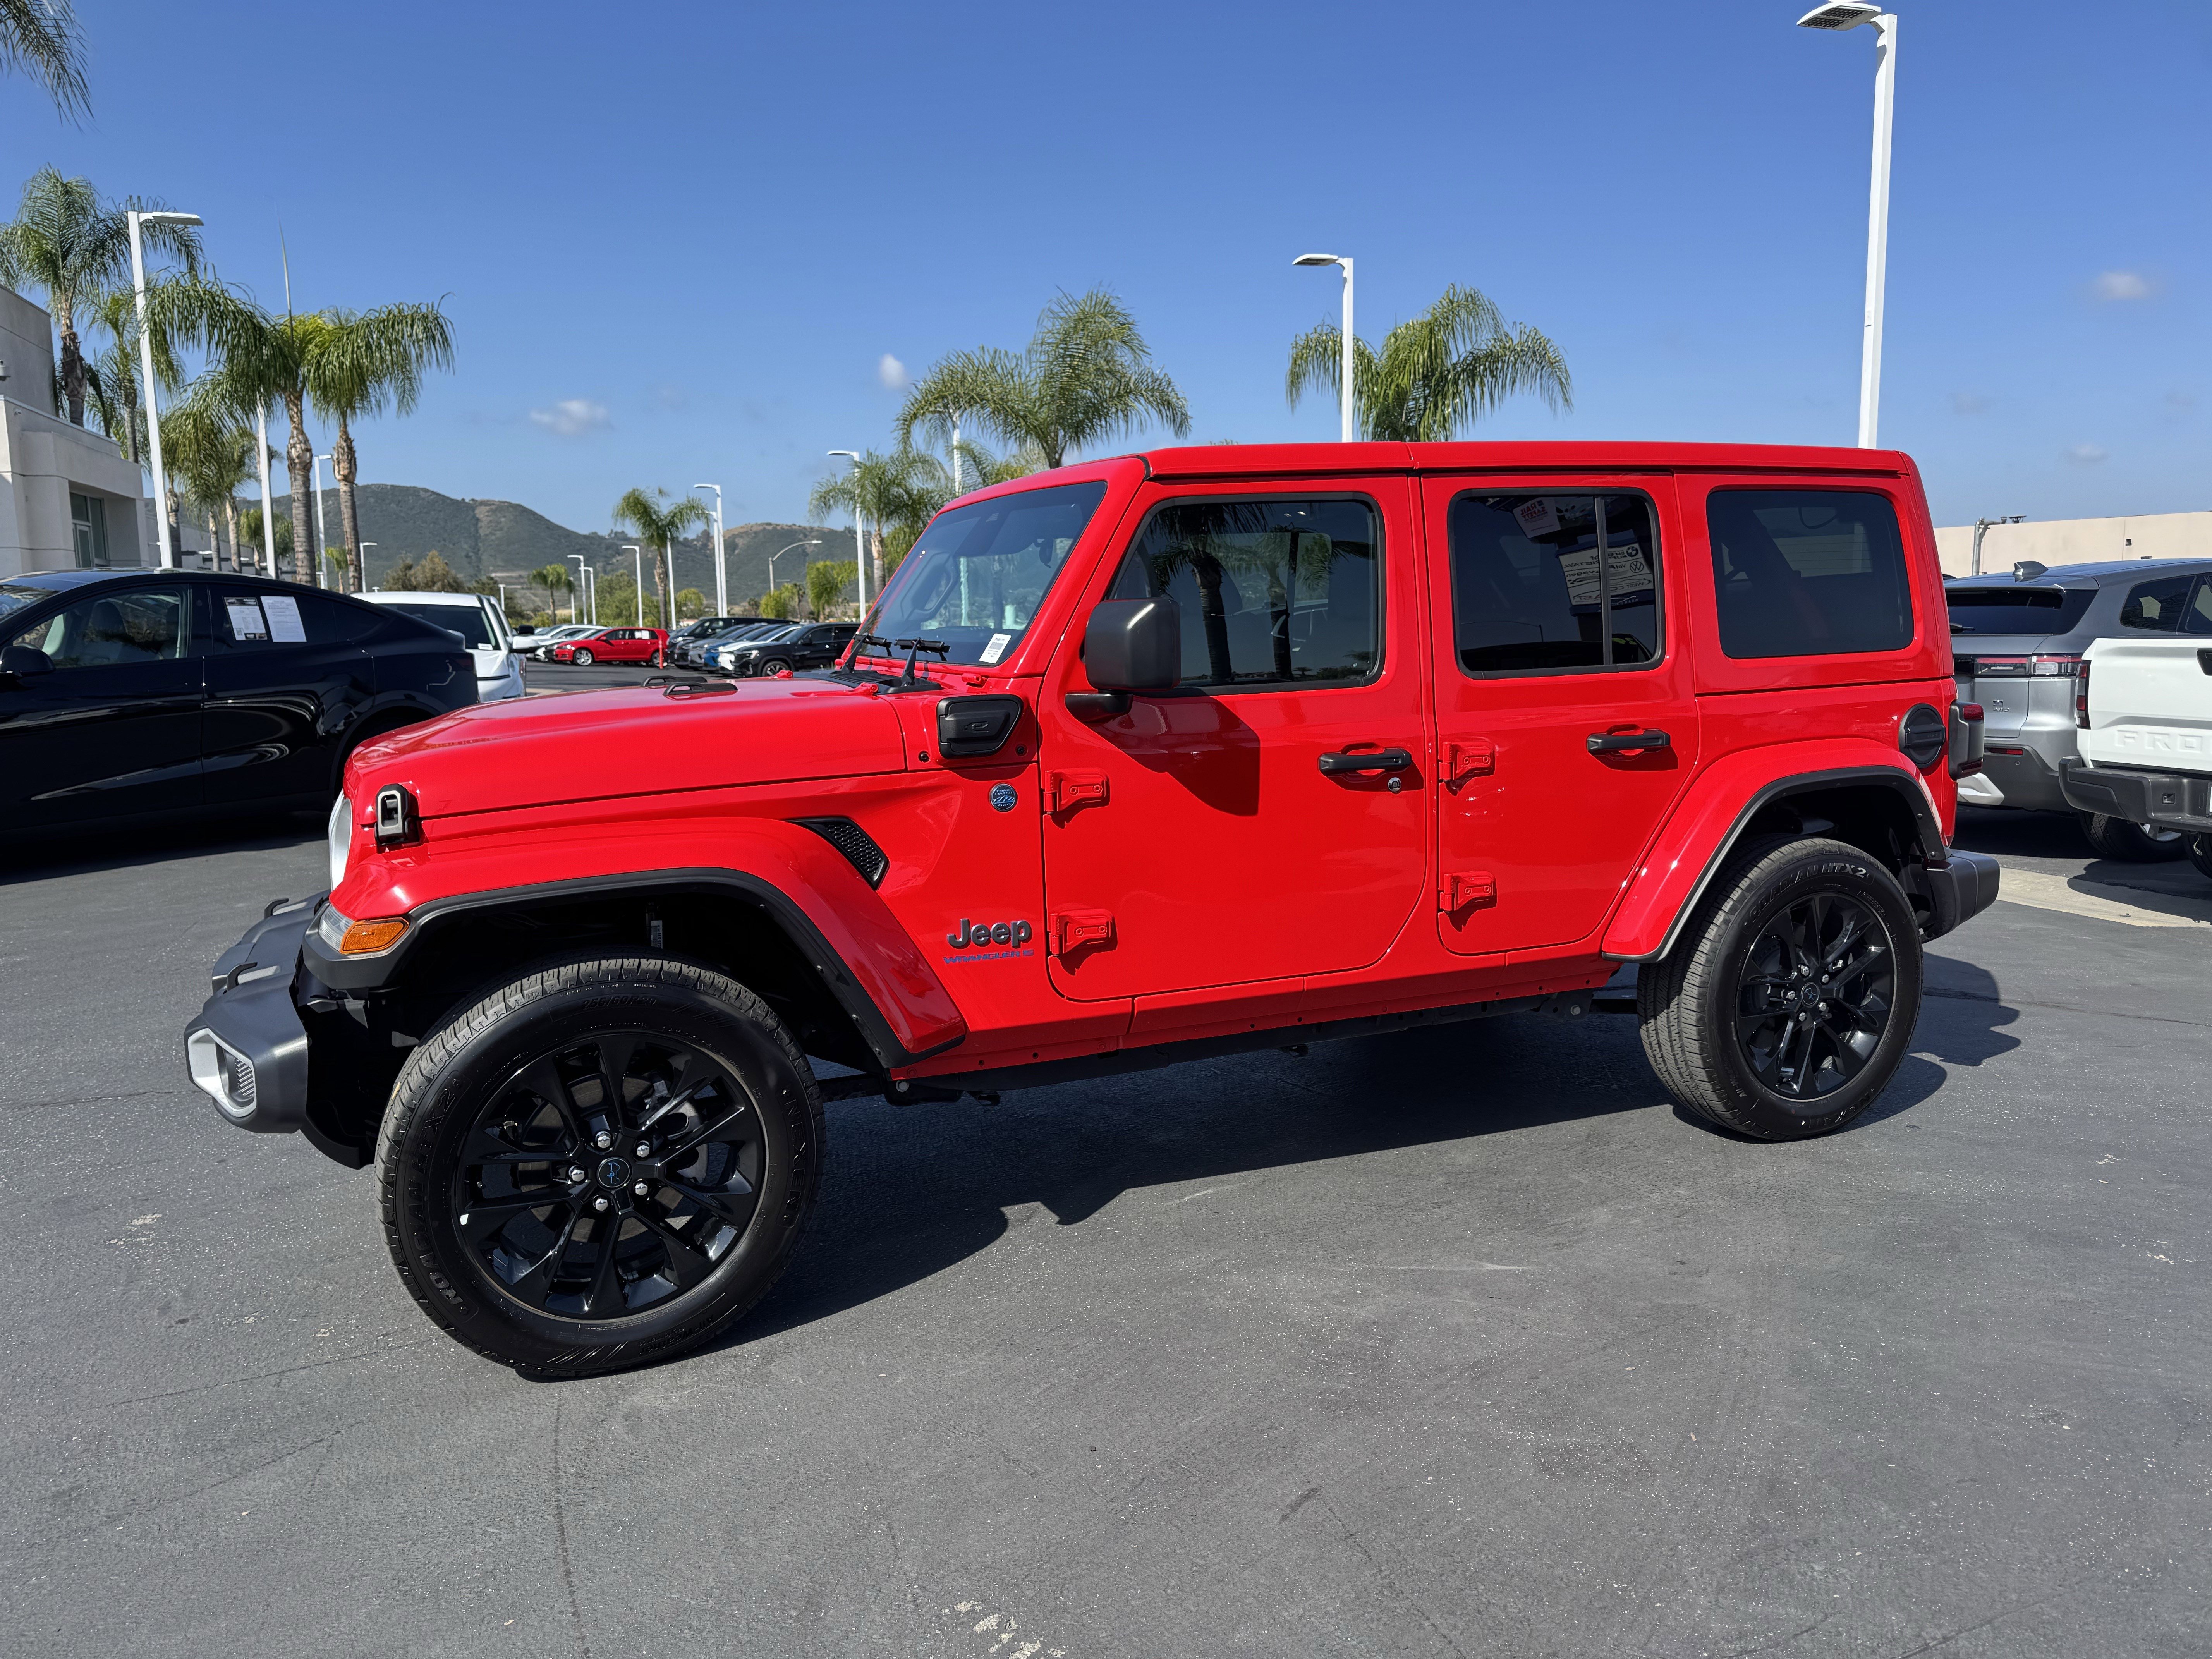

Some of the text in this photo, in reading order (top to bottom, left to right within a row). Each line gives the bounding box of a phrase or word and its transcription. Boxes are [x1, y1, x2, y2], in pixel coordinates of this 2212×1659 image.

[1822, 862, 1867, 878] HTX2
[947, 918, 1032, 948] Jeep
[943, 951, 1020, 963] WRANGLER
[784, 1098, 806, 1211] NEXEN
